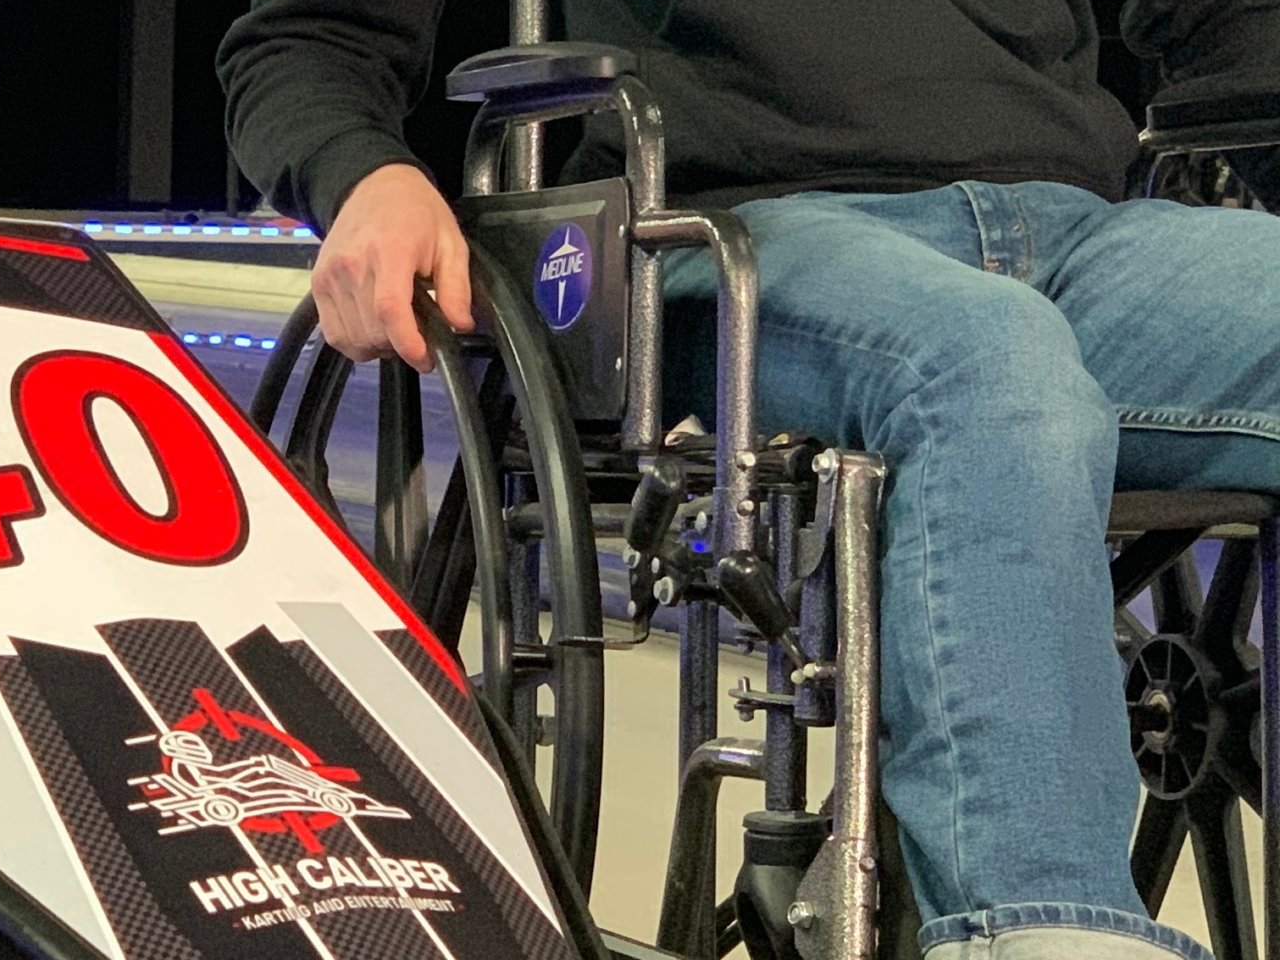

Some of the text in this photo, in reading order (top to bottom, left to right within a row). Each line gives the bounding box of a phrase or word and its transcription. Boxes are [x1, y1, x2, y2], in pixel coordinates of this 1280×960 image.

[541, 253, 584, 282] MEDLINE
[189, 856, 461, 914] HIGH CALIBER
[313, 897, 345, 918] AND
